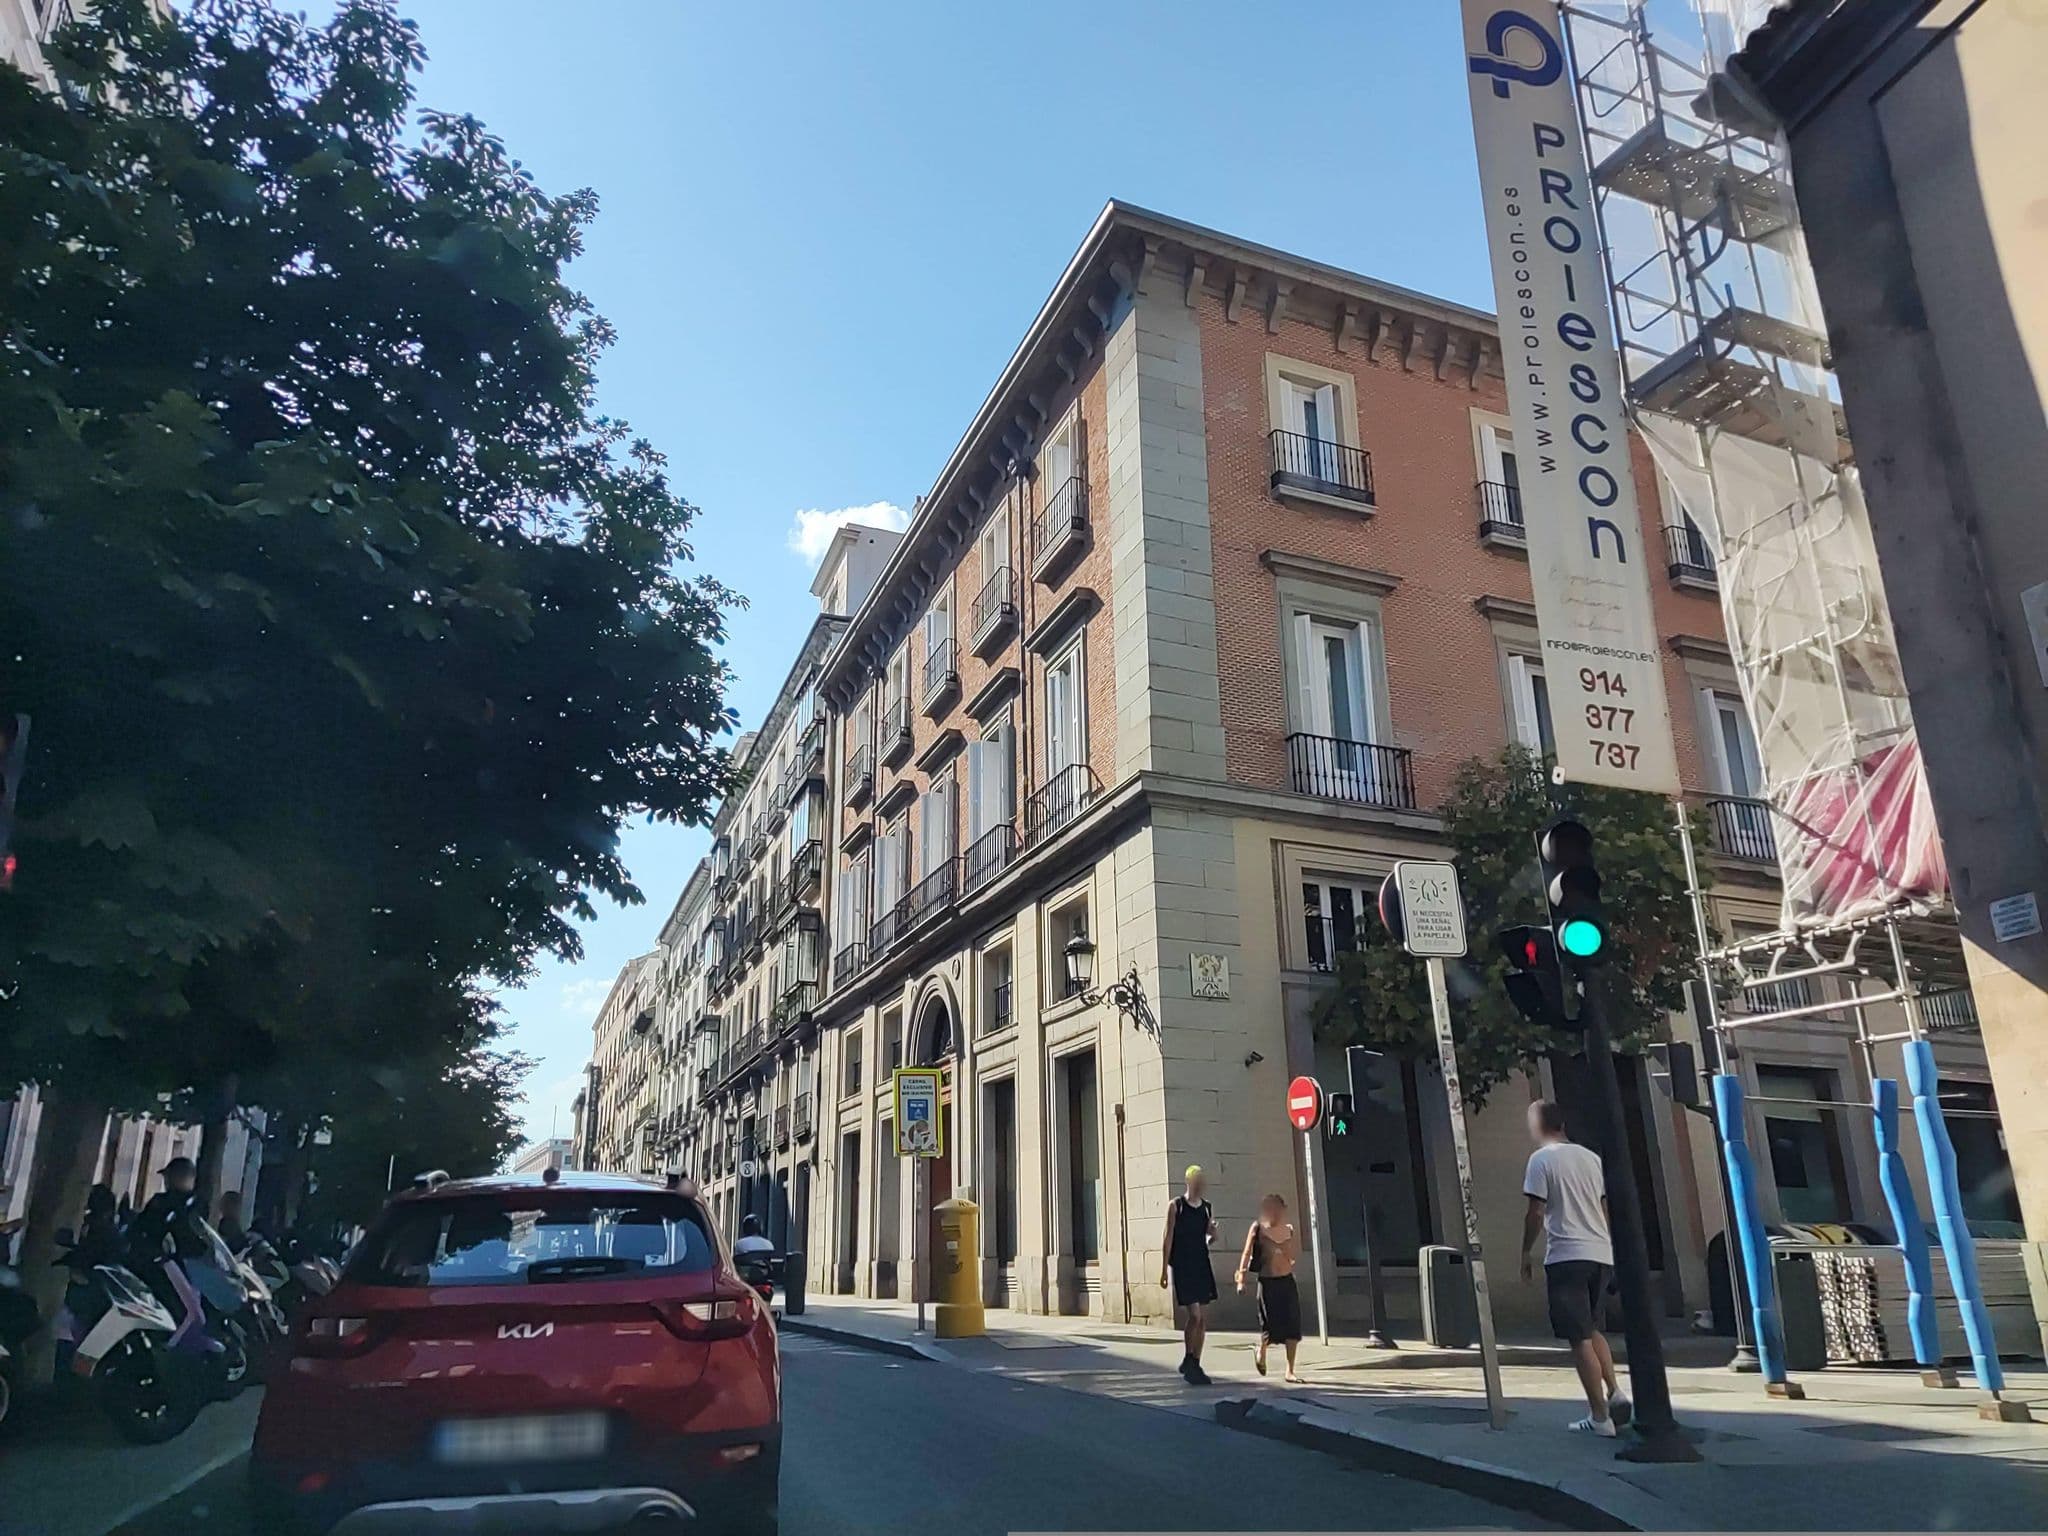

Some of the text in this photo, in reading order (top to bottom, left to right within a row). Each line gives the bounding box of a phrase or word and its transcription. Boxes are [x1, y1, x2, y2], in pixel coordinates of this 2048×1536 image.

[1579, 667, 1628, 698] 914
[1585, 704, 1635, 734] 377
[1589, 740, 1641, 771] 737
[497, 1322, 554, 1338] KIA
